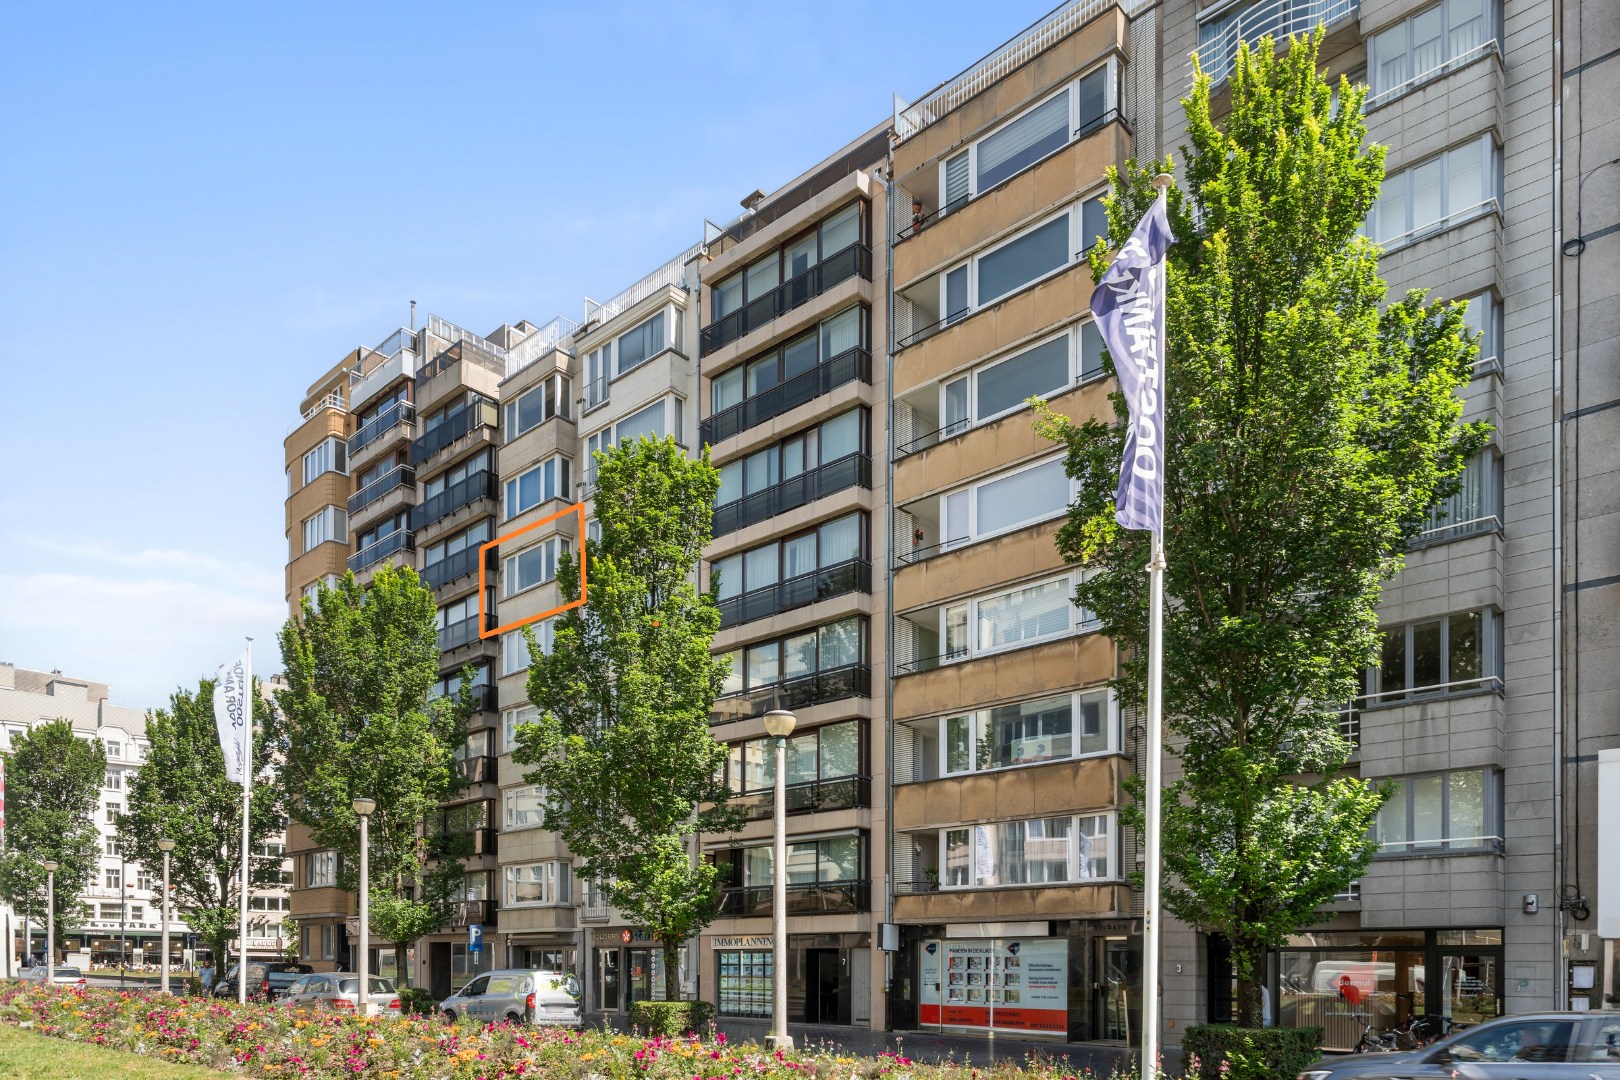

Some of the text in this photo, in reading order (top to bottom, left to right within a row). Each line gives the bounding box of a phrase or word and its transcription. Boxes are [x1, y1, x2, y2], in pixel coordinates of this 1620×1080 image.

[471, 928, 481, 943] P
[714, 937, 773, 947] IMMOPLANNIN
[1176, 964, 1182, 973] 3
